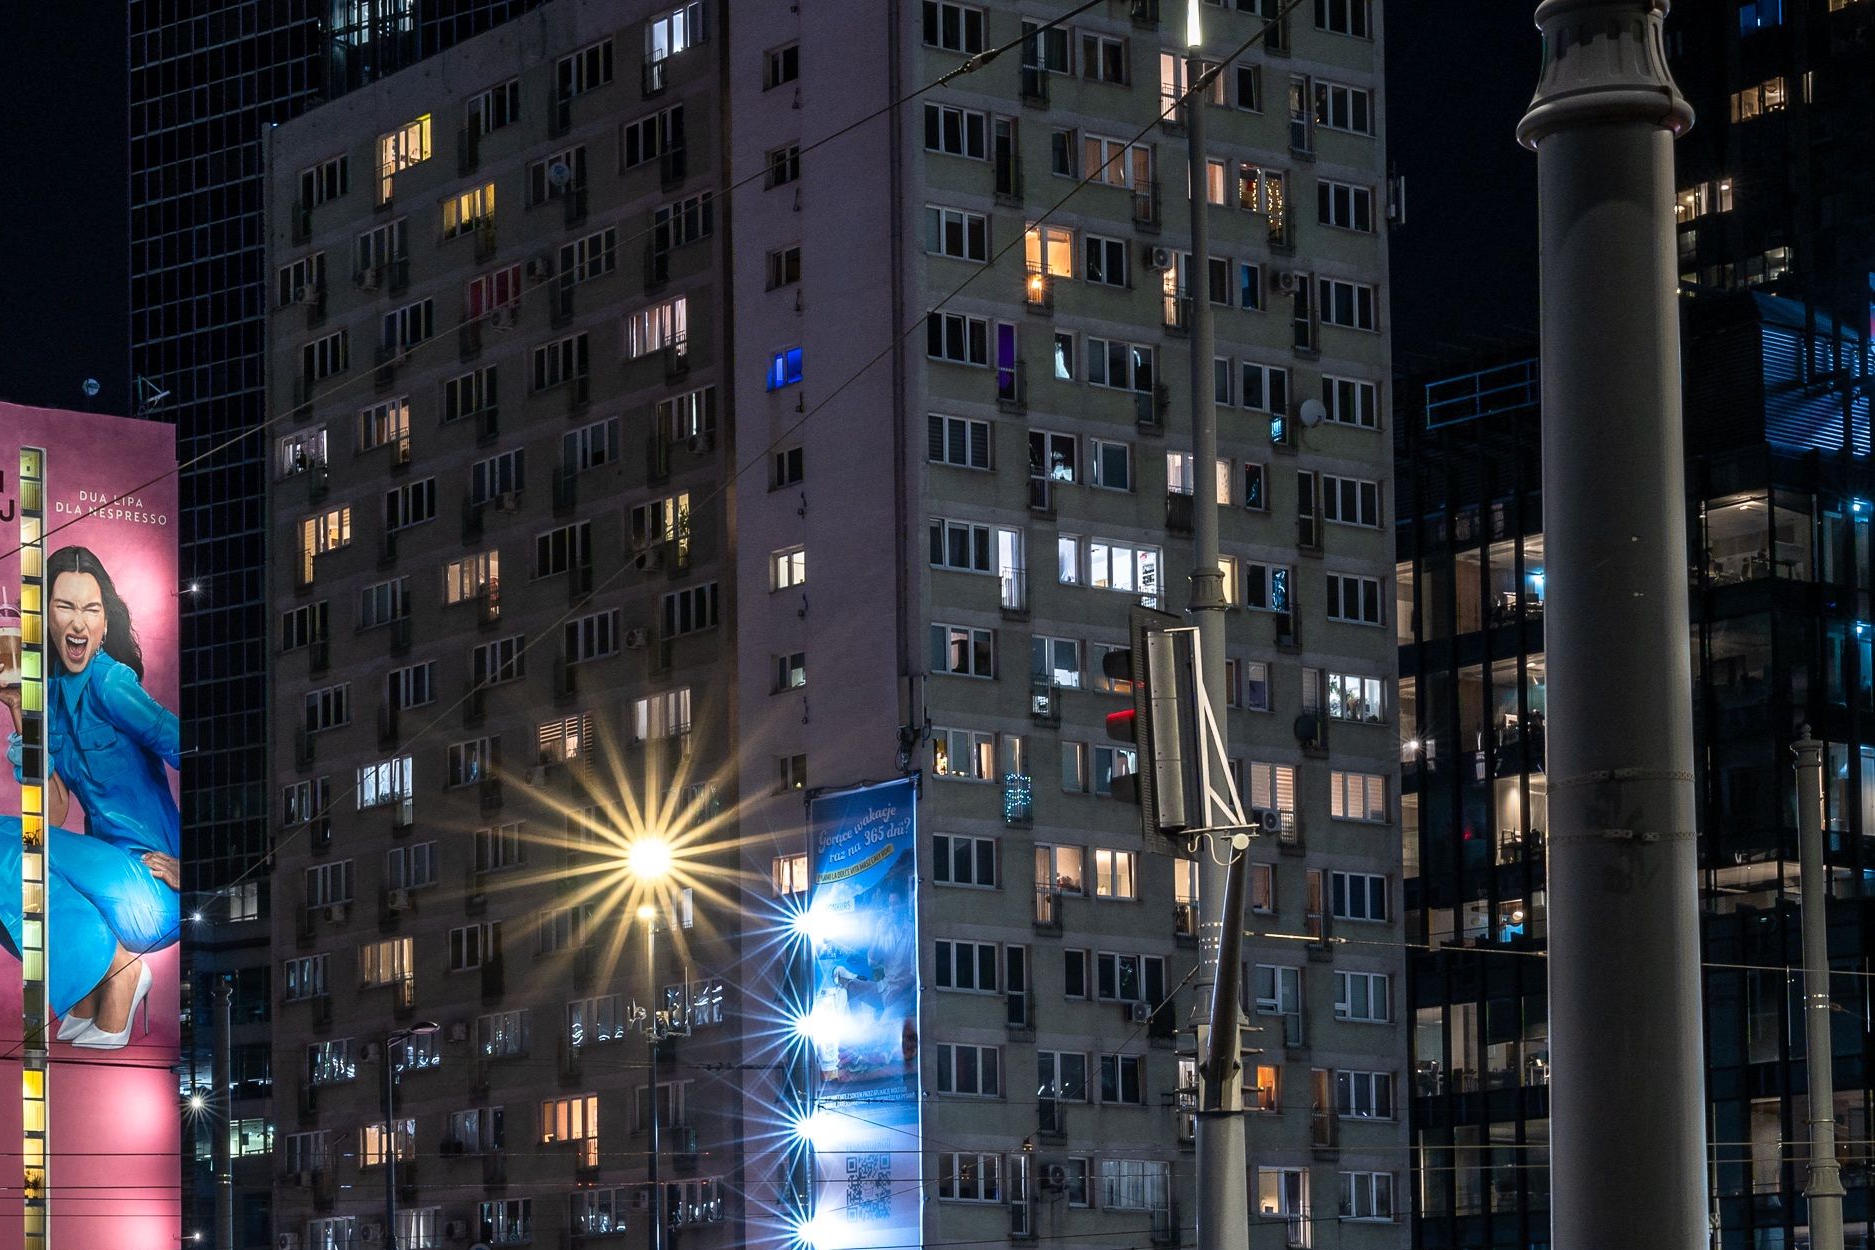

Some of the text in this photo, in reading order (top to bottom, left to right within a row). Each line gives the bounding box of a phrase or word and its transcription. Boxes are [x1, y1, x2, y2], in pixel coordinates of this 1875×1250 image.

[79, 490, 144, 509] DUA LIPA
[55, 502, 168, 526] DLA NESPRESSO
[854, 803, 896, 834] wakacje
[829, 817, 911, 864] raz na 365 dni?
